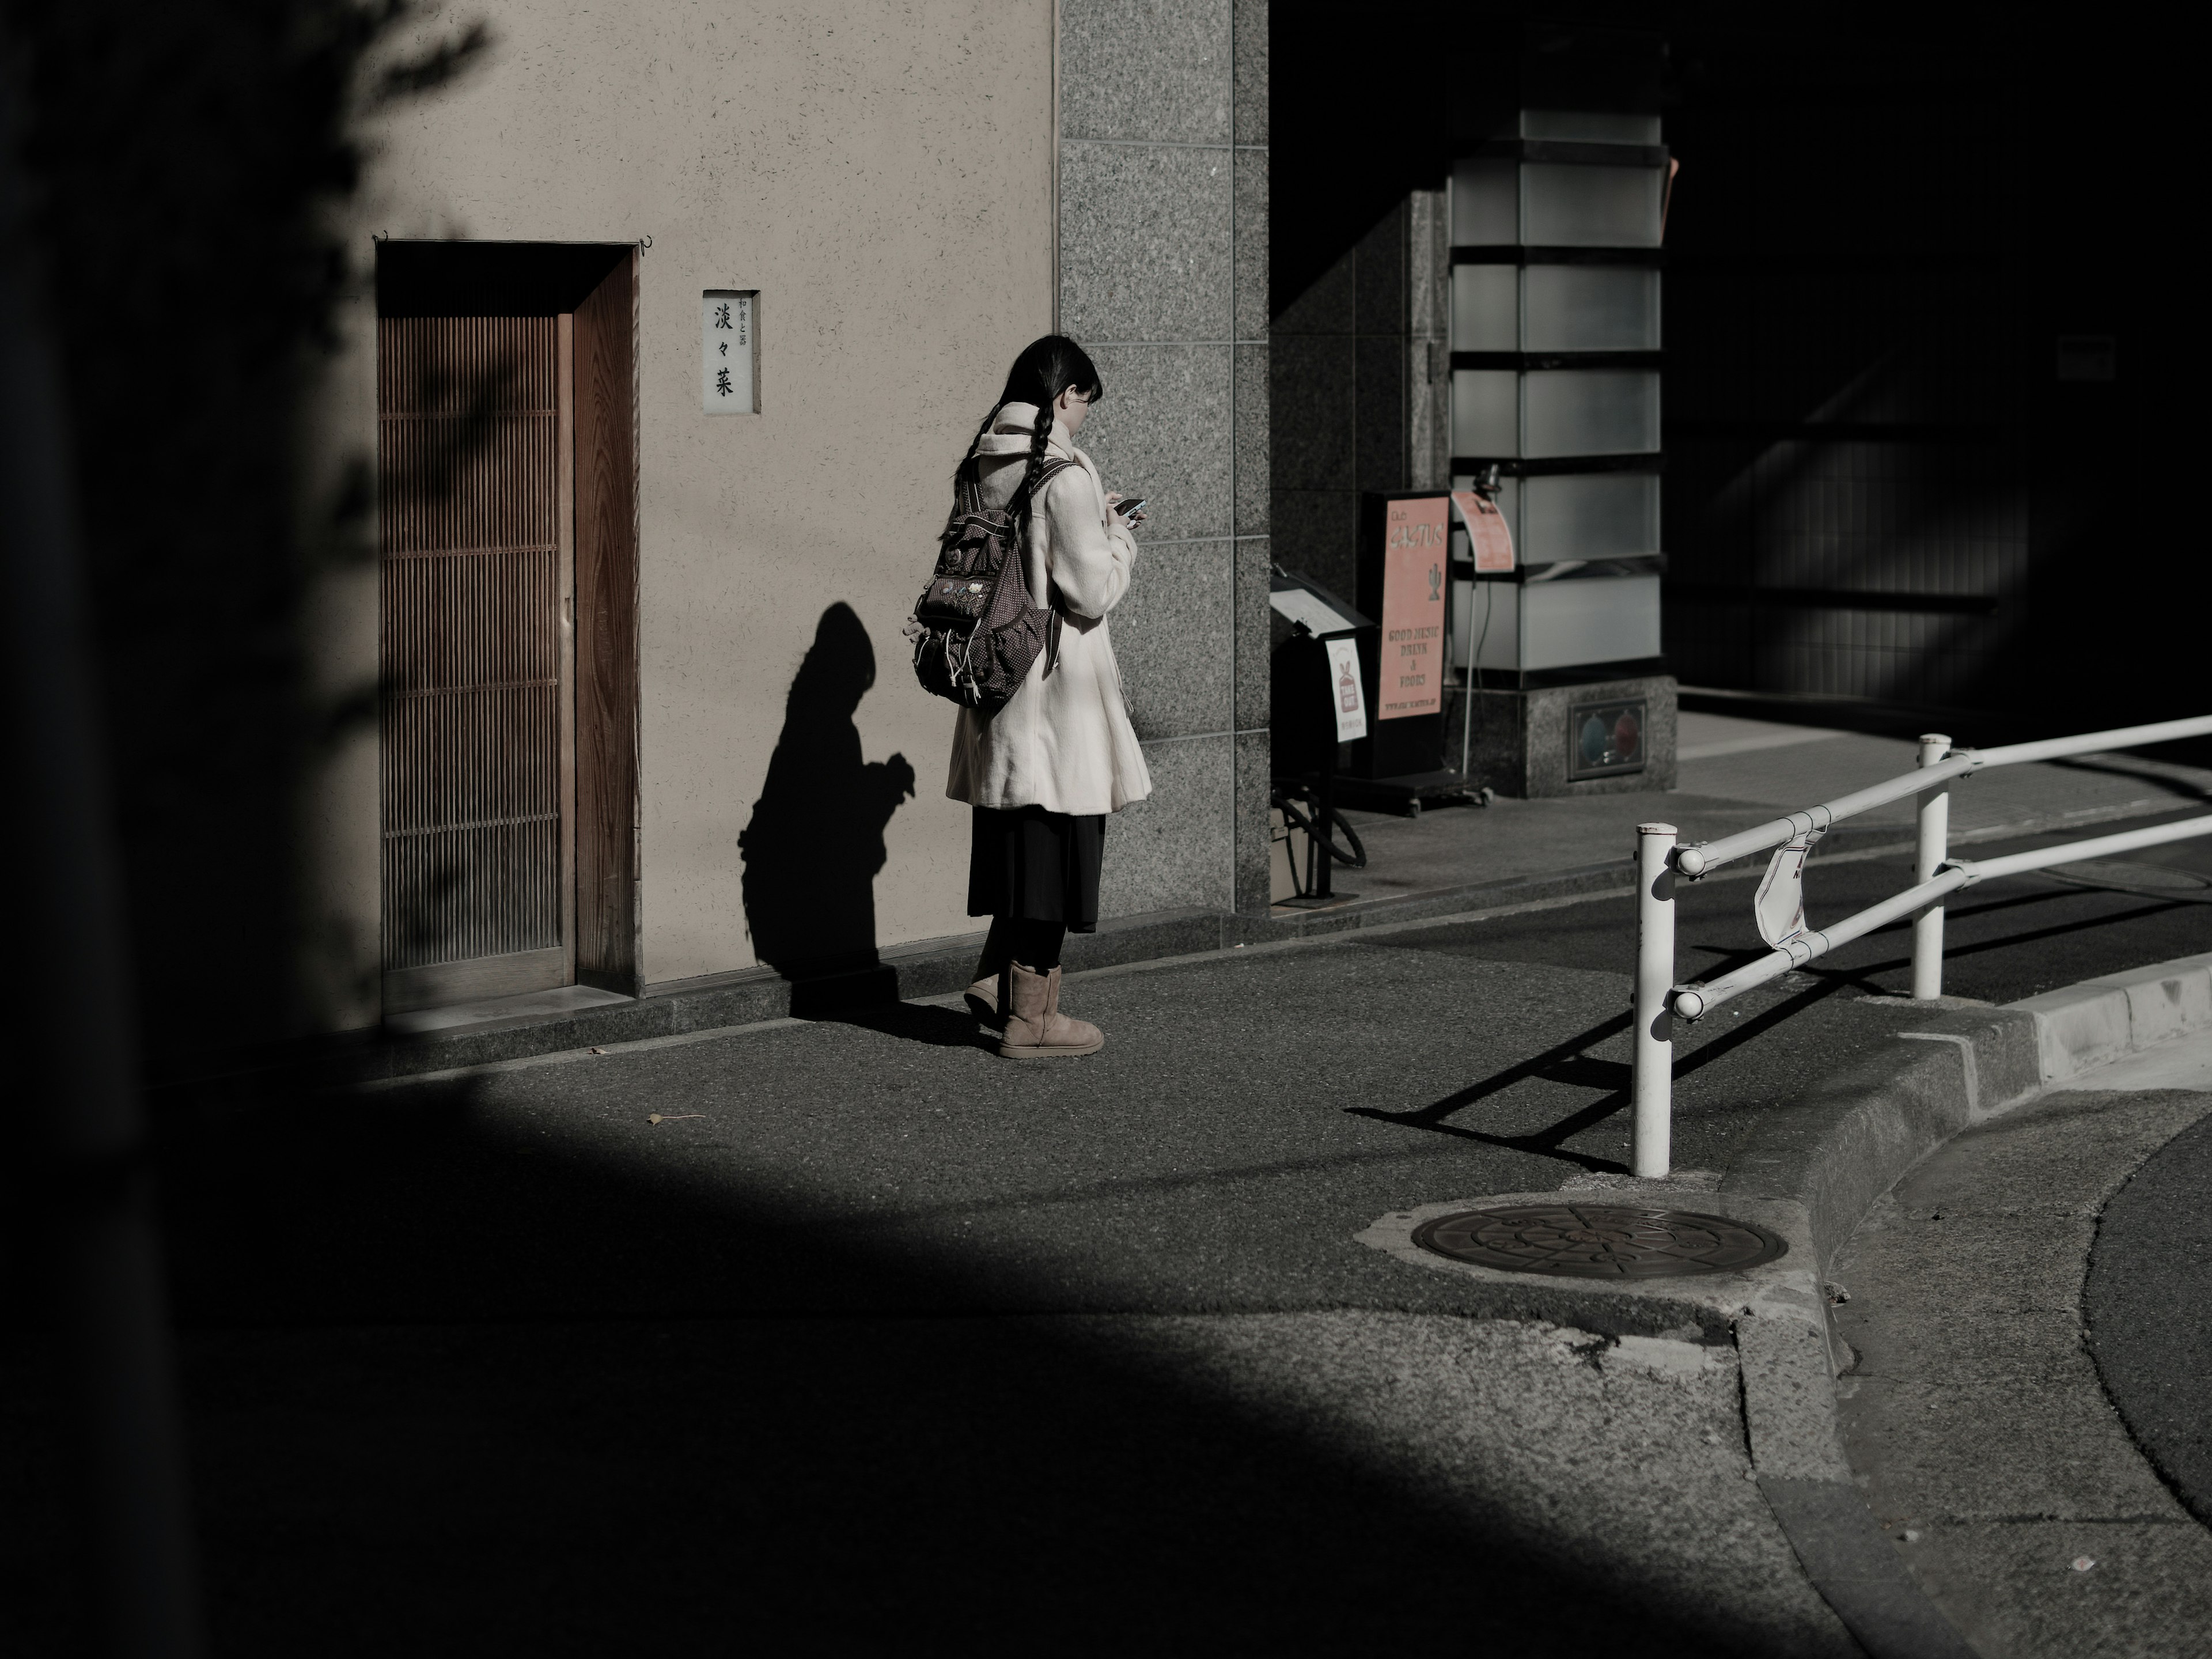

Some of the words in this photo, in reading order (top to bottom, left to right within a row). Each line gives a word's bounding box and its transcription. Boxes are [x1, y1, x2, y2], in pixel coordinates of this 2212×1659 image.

[714, 303, 733, 397] 淡々菜
[1388, 628, 1412, 642] GOOD
[1414, 626, 1440, 640] MUSIC
[1400, 642, 1427, 657] DRINK
[1400, 673, 1426, 688] FOODS
